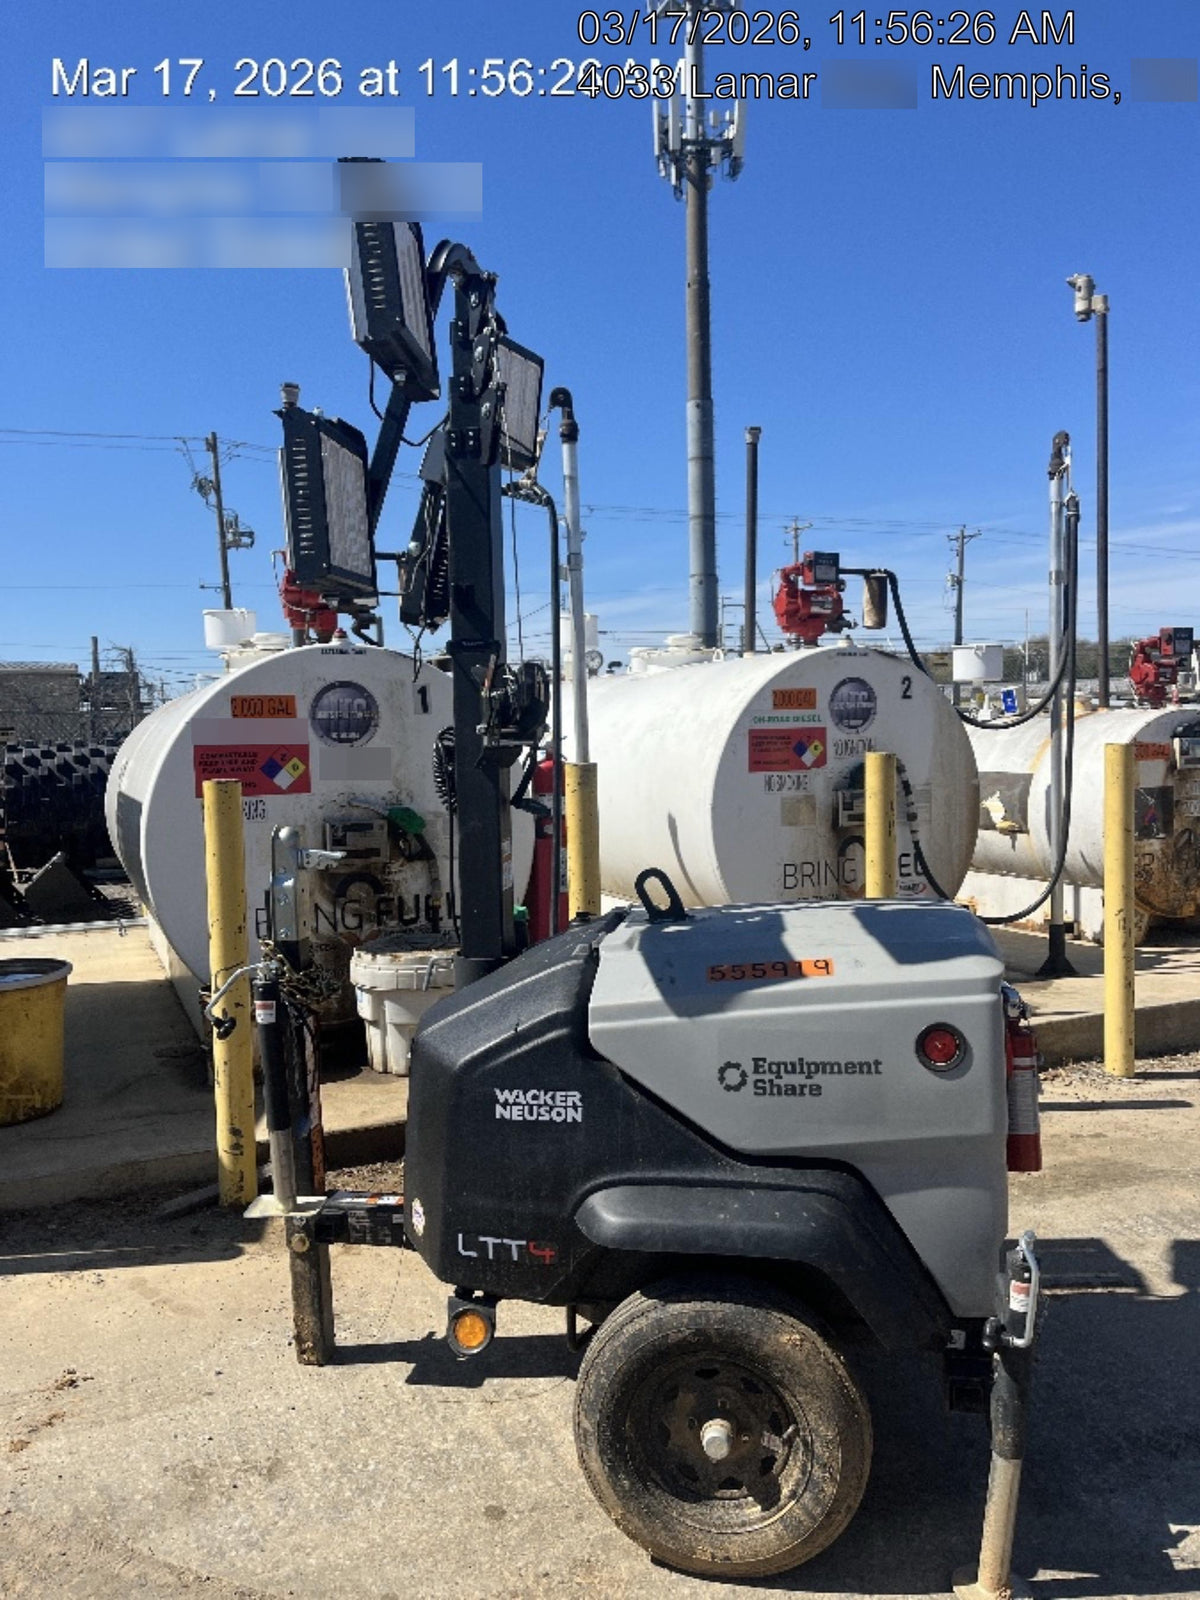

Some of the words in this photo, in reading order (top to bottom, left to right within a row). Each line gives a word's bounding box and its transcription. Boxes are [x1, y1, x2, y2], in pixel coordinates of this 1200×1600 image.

[417, 685, 429, 713] 1
[901, 676, 912, 700] 2
[267, 697, 292, 716] GAL
[783, 858, 857, 889] BRING
[709, 959, 831, 982] 555919
[752, 1057, 882, 1079] Equipment
[494, 1088, 582, 1107] WACKER
[753, 1077, 823, 1098] Share
[495, 1105, 582, 1123] NEUSON
[458, 1232, 556, 1264] LTT4
